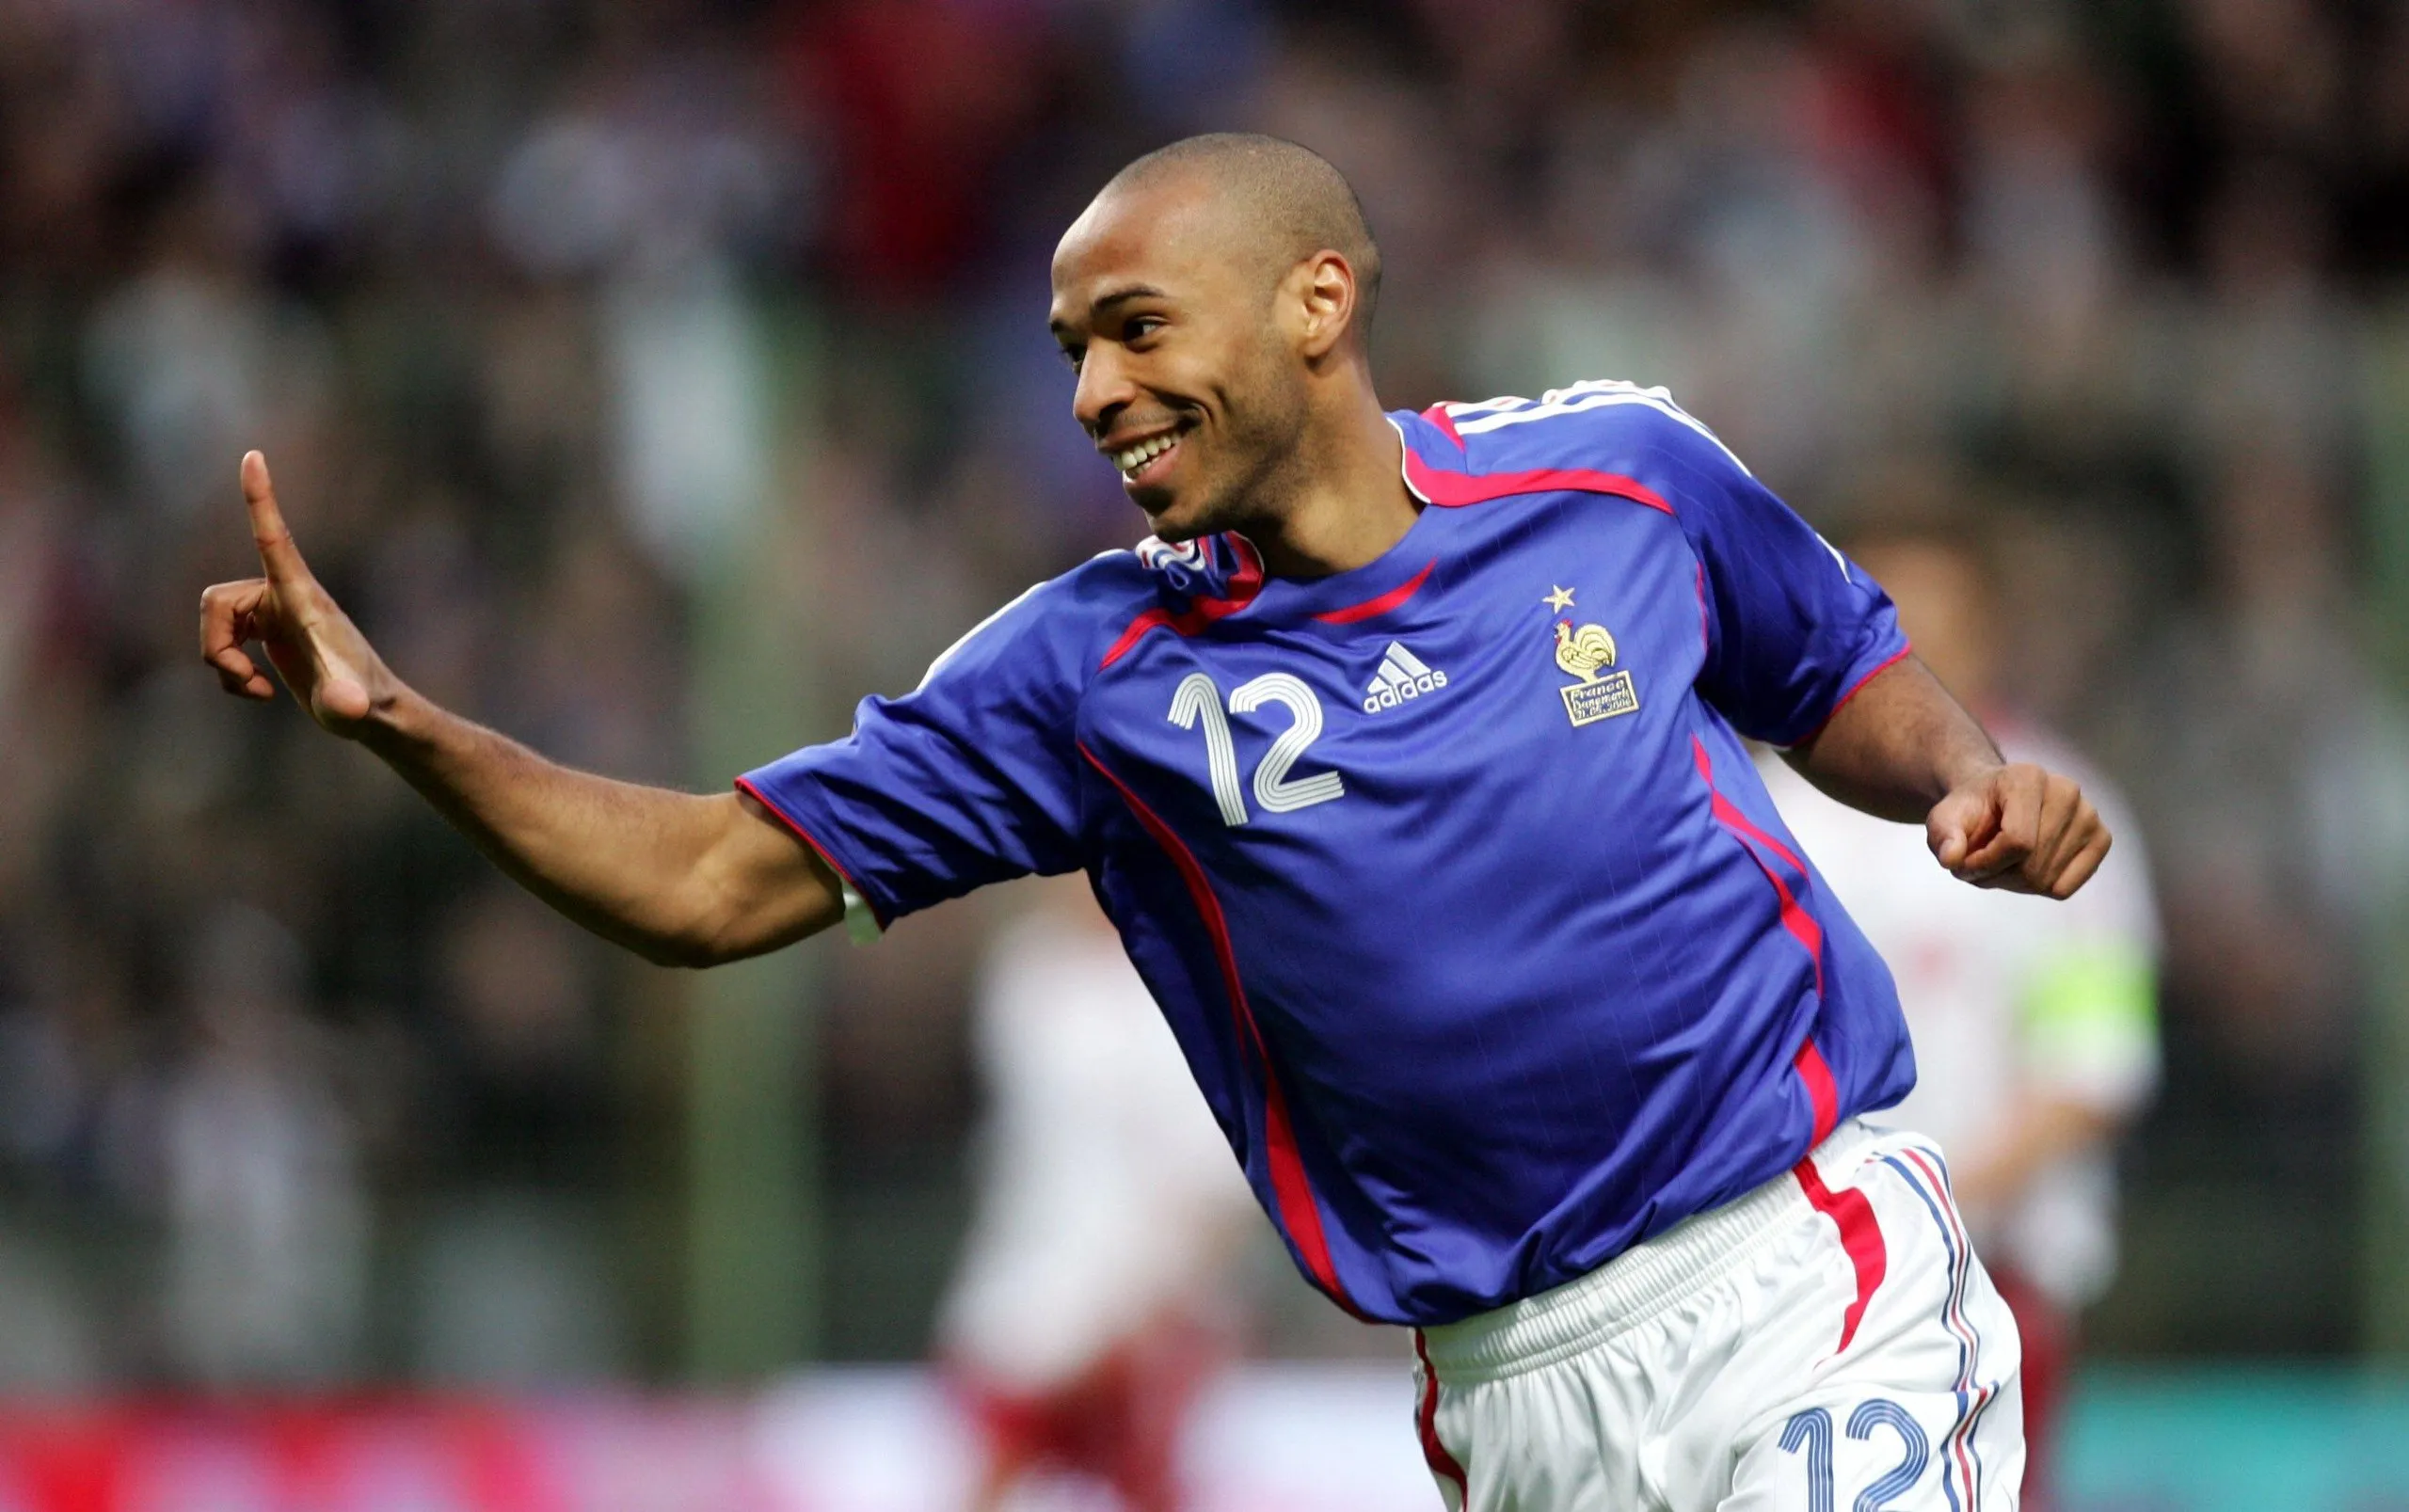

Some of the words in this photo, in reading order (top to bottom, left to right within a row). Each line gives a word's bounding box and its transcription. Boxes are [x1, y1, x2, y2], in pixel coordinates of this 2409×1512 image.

[1364, 670, 1447, 714] adidas
[1571, 679, 1624, 702] France
[1167, 672, 1345, 827] 12
[1777, 1398, 1930, 1512] 12
